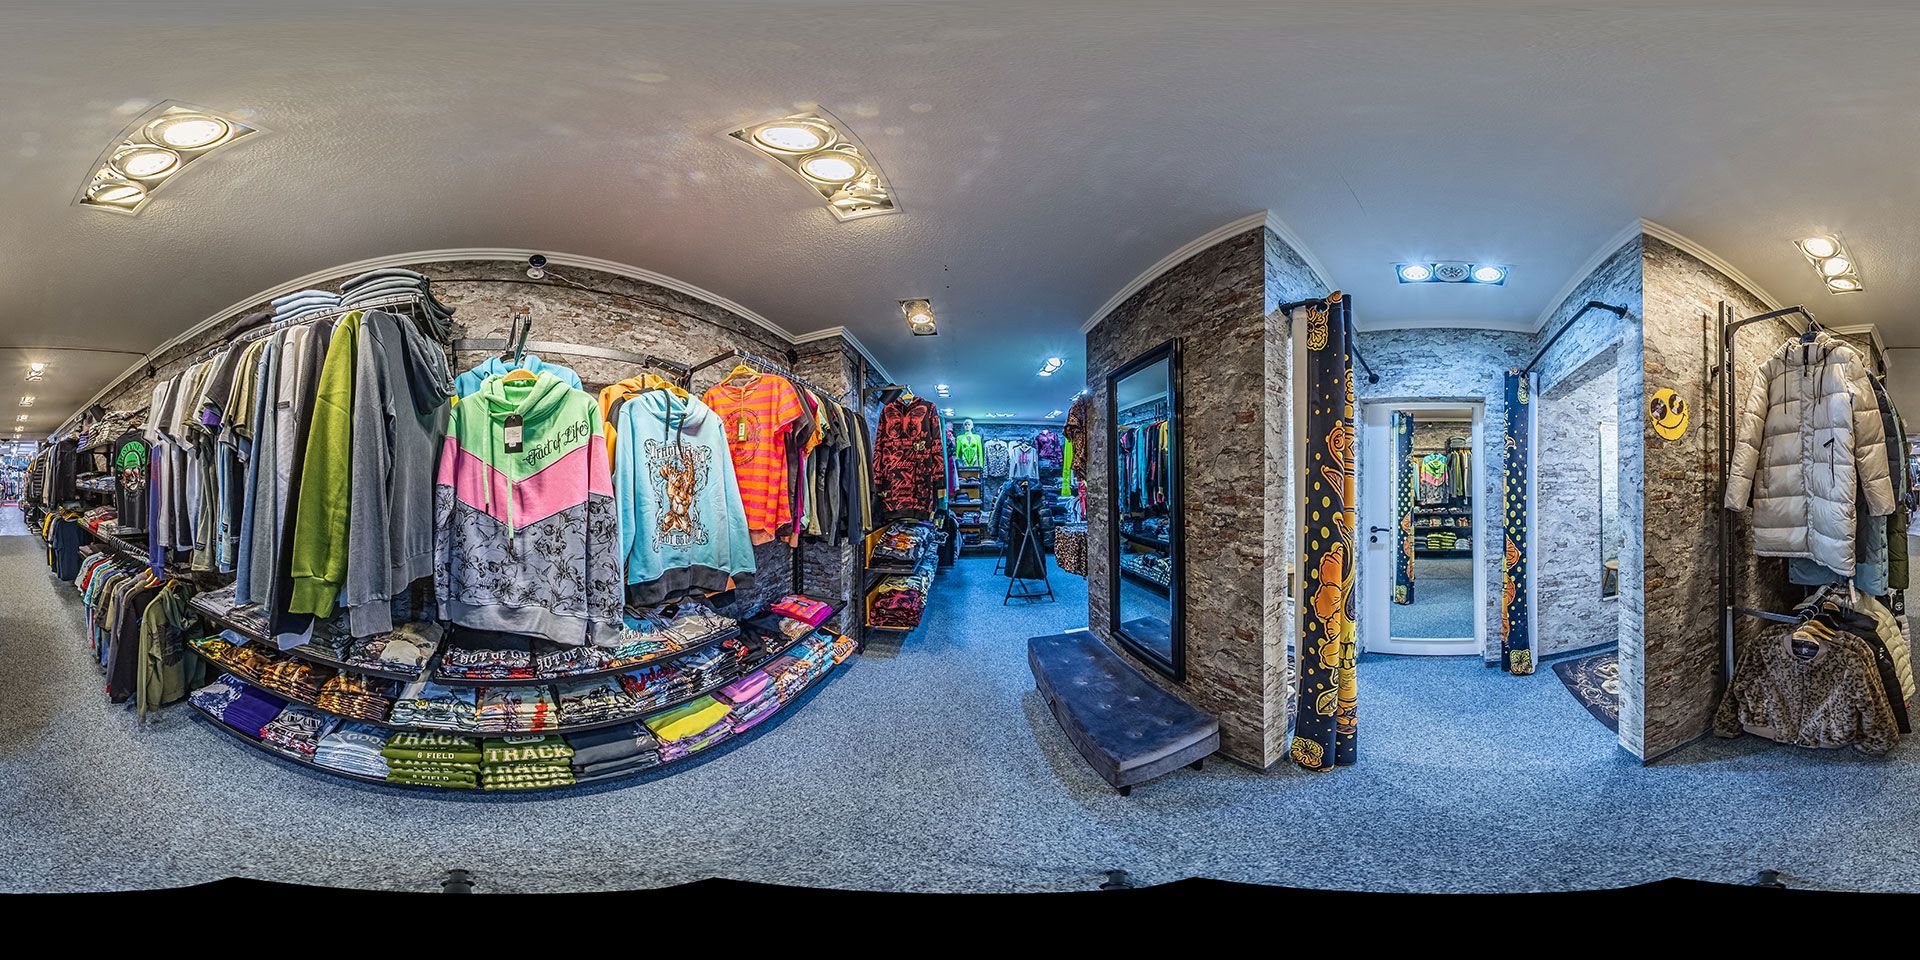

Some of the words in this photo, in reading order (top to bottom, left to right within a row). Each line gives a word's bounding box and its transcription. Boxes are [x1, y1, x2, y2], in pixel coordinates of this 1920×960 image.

[523, 439, 553, 466] Fact
[553, 432, 561, 453] of
[561, 420, 589, 446] Life
[393, 731, 469, 746] TRACK
[426, 752, 455, 760] FIELD
[486, 744, 574, 762] TRACK
